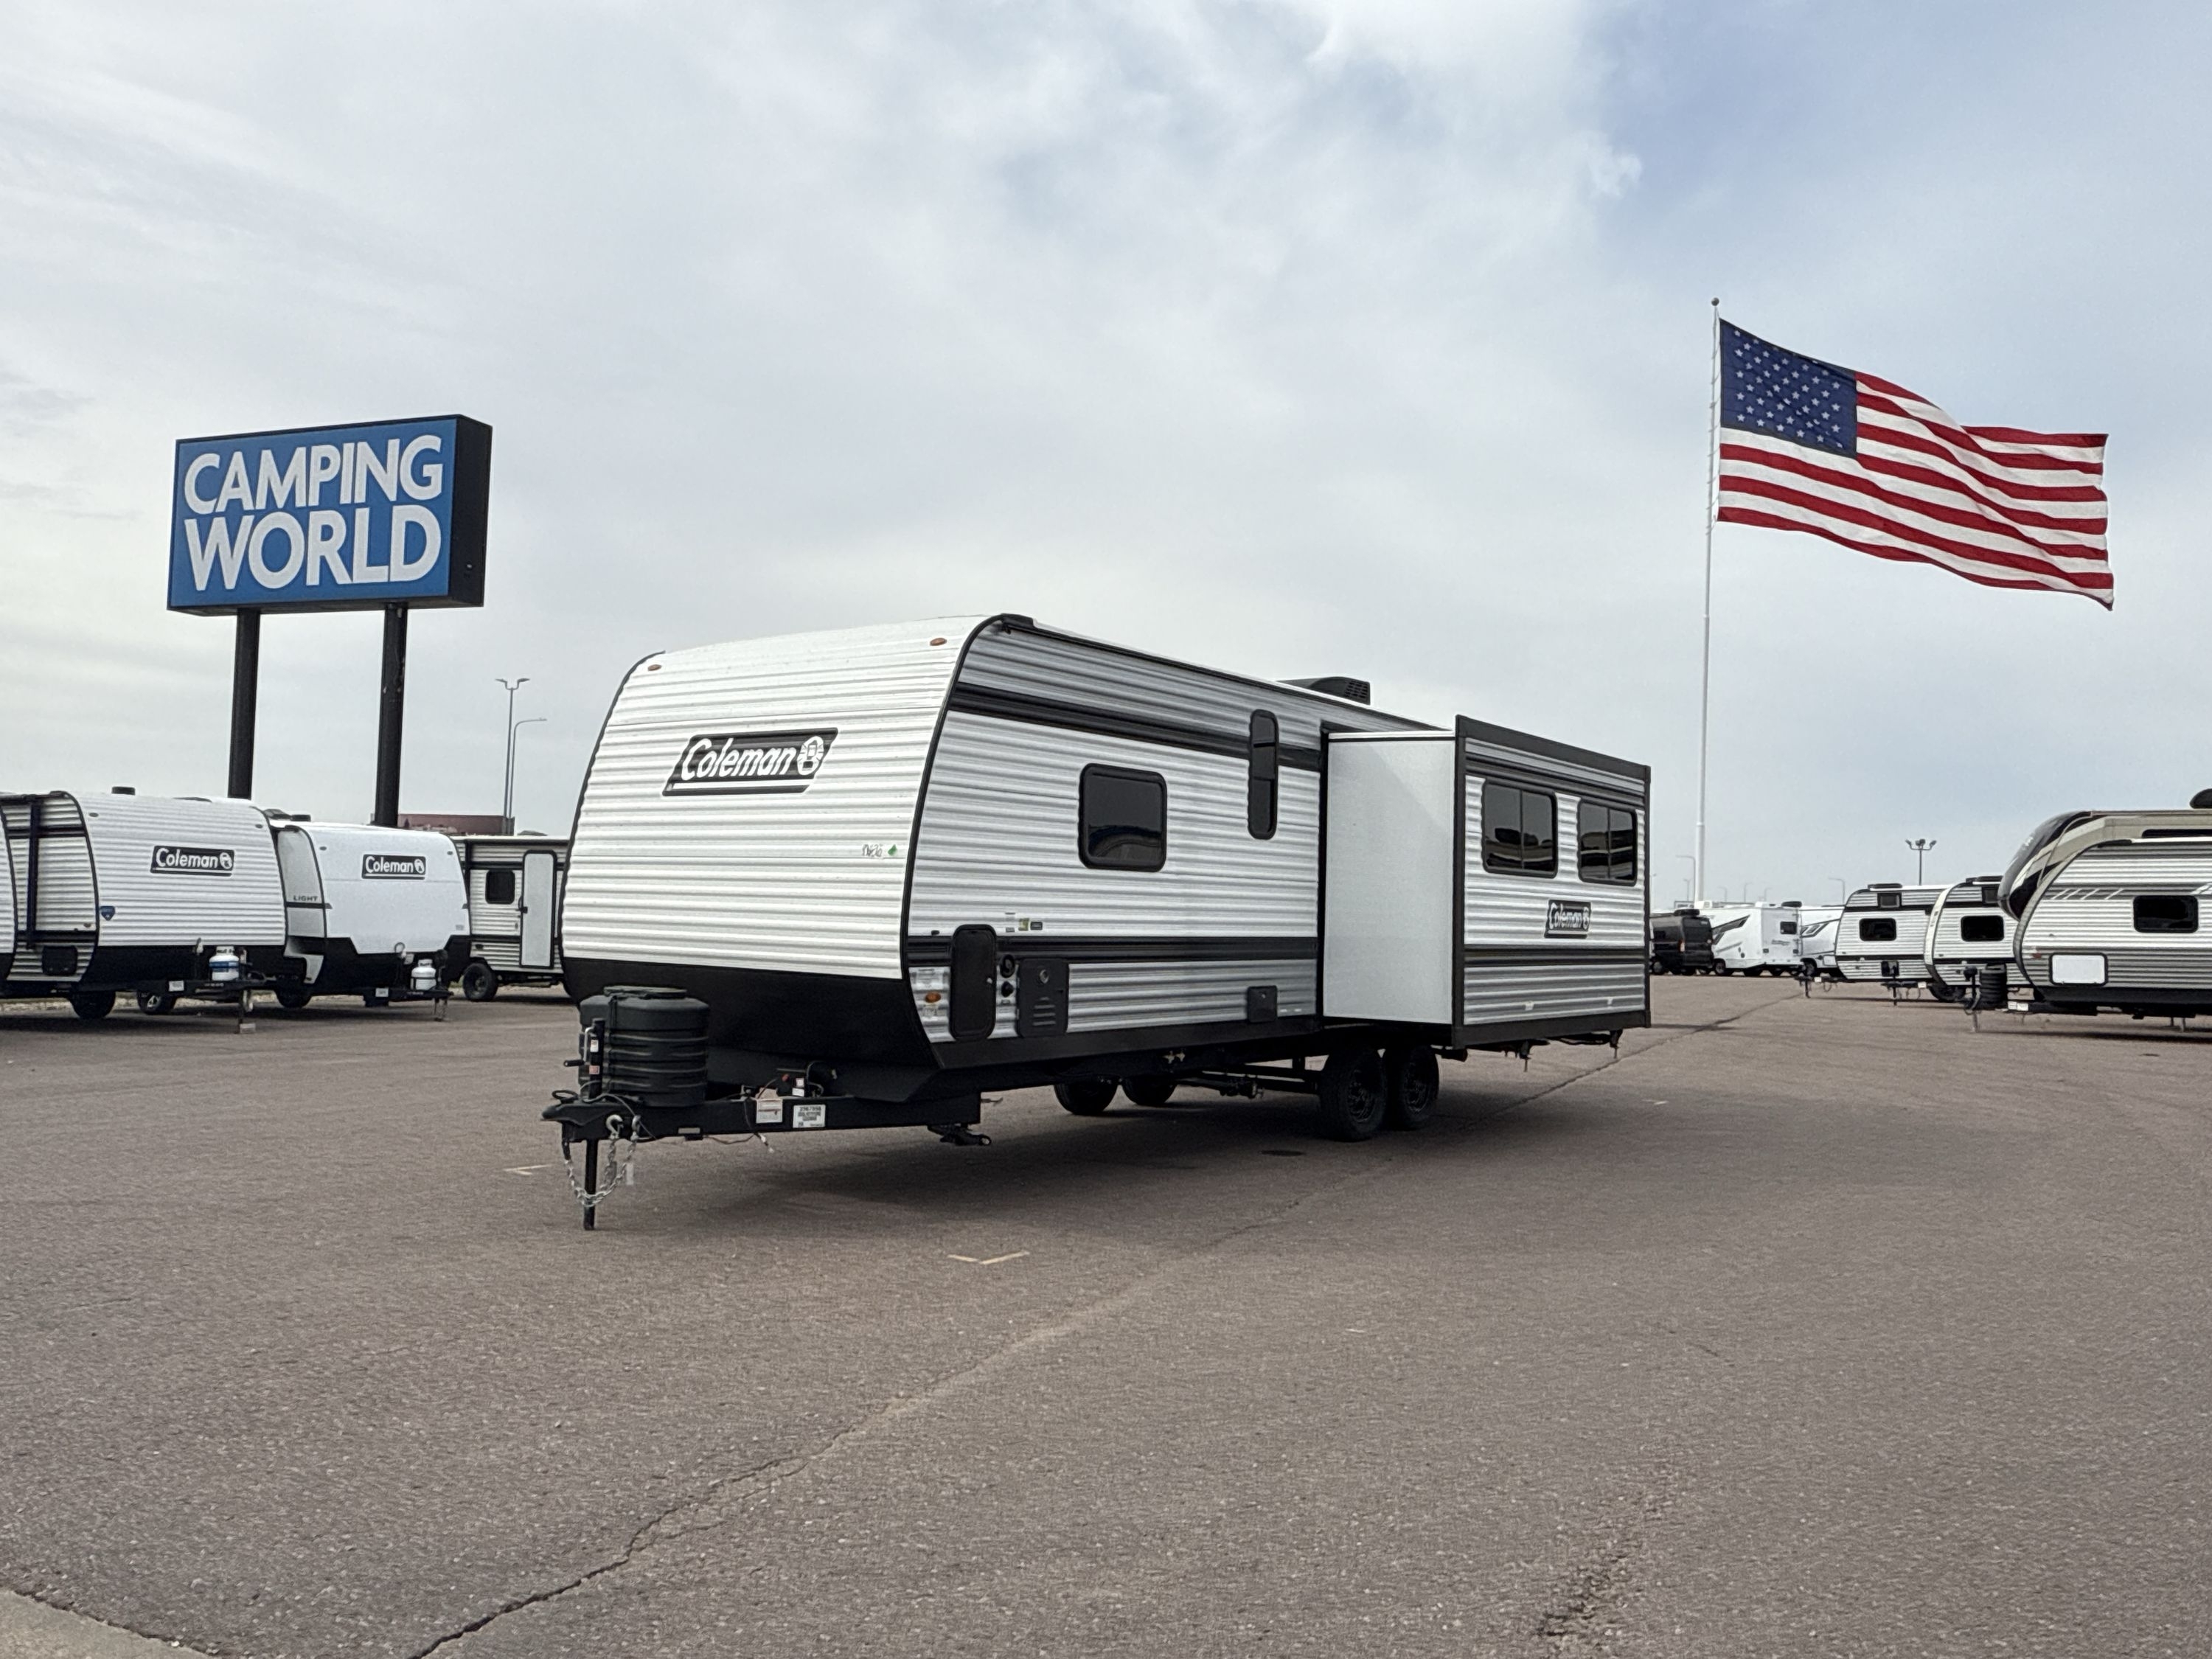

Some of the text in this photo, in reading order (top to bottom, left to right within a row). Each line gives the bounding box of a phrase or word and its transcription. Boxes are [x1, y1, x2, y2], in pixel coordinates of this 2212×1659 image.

[184, 434, 442, 515] CAMPING
[184, 504, 442, 591] WORLD
[681, 737, 797, 781] Coleman
[156, 847, 219, 869] Coleman
[365, 856, 414, 874] Coleman
[1549, 902, 1582, 929] Coleman
